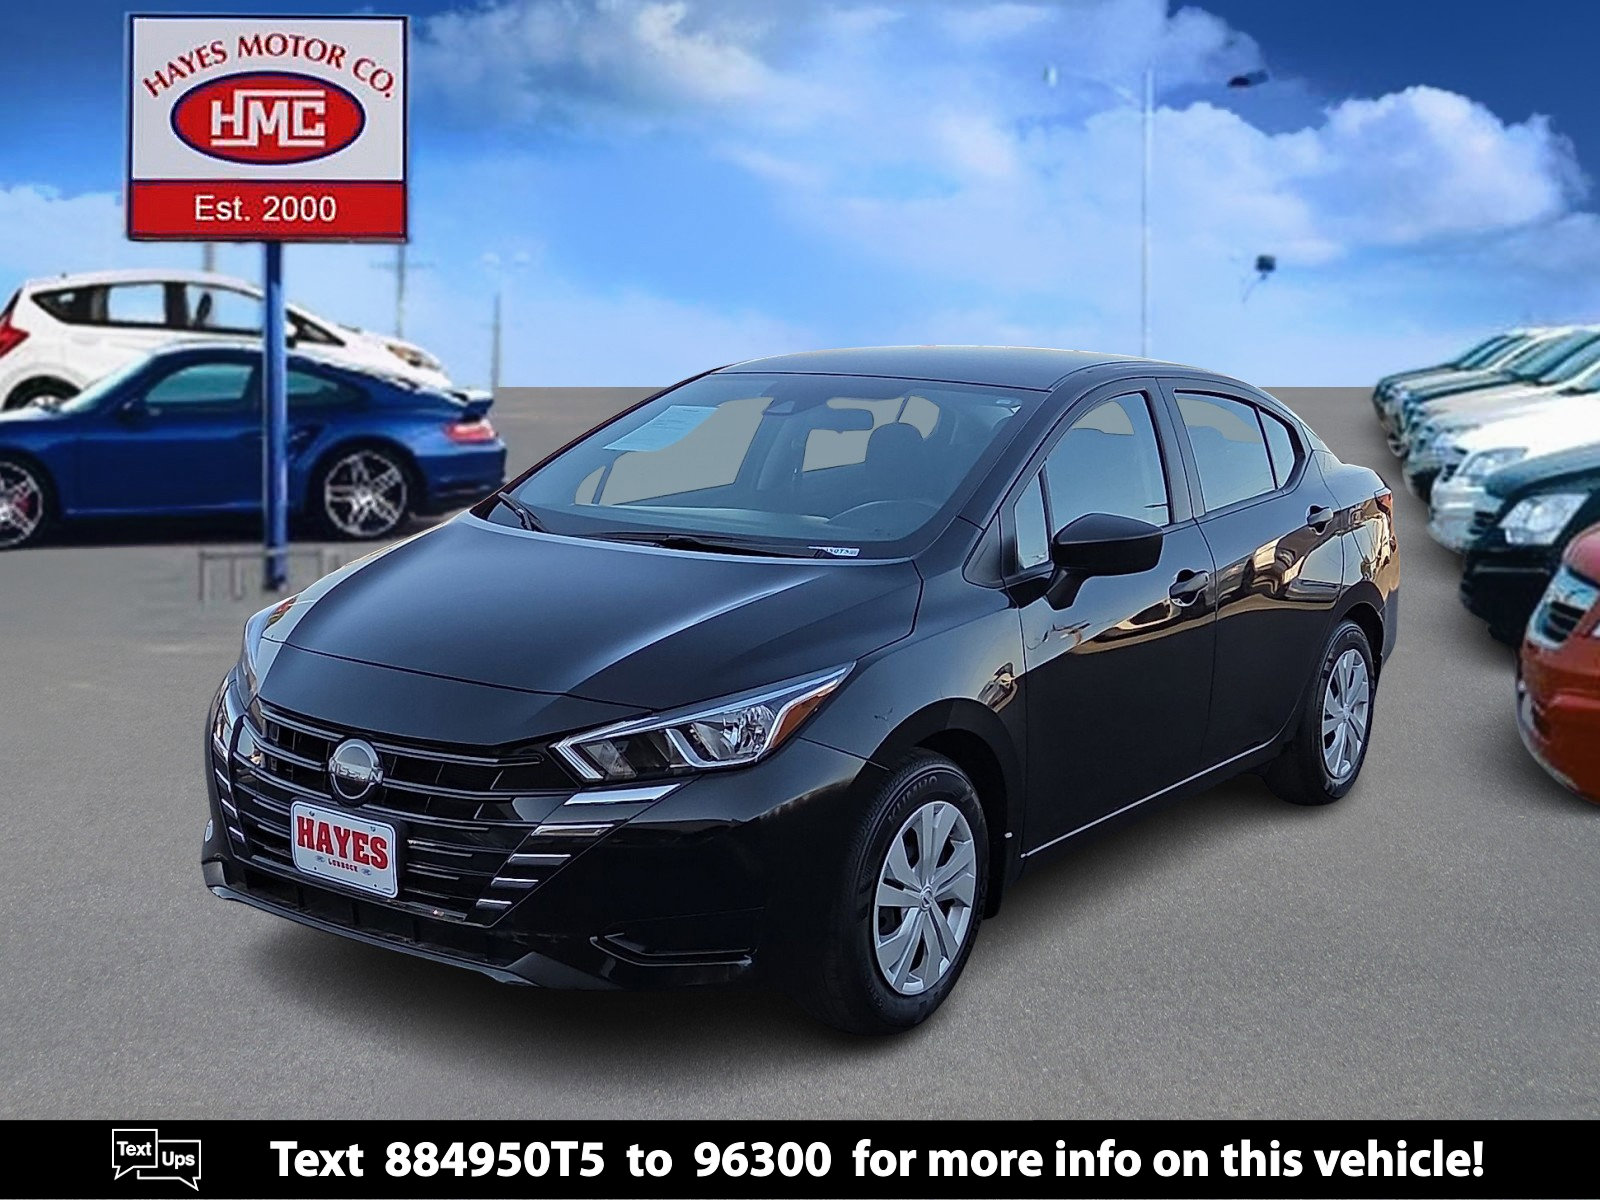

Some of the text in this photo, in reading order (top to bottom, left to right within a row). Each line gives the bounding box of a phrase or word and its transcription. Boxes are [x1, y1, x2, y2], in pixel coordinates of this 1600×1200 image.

[143, 33, 395, 98] HAYES MOTOR CO.
[210, 89, 326, 147] HMC
[194, 195, 337, 221] Est. 2000
[297, 816, 389, 870] HAYES
